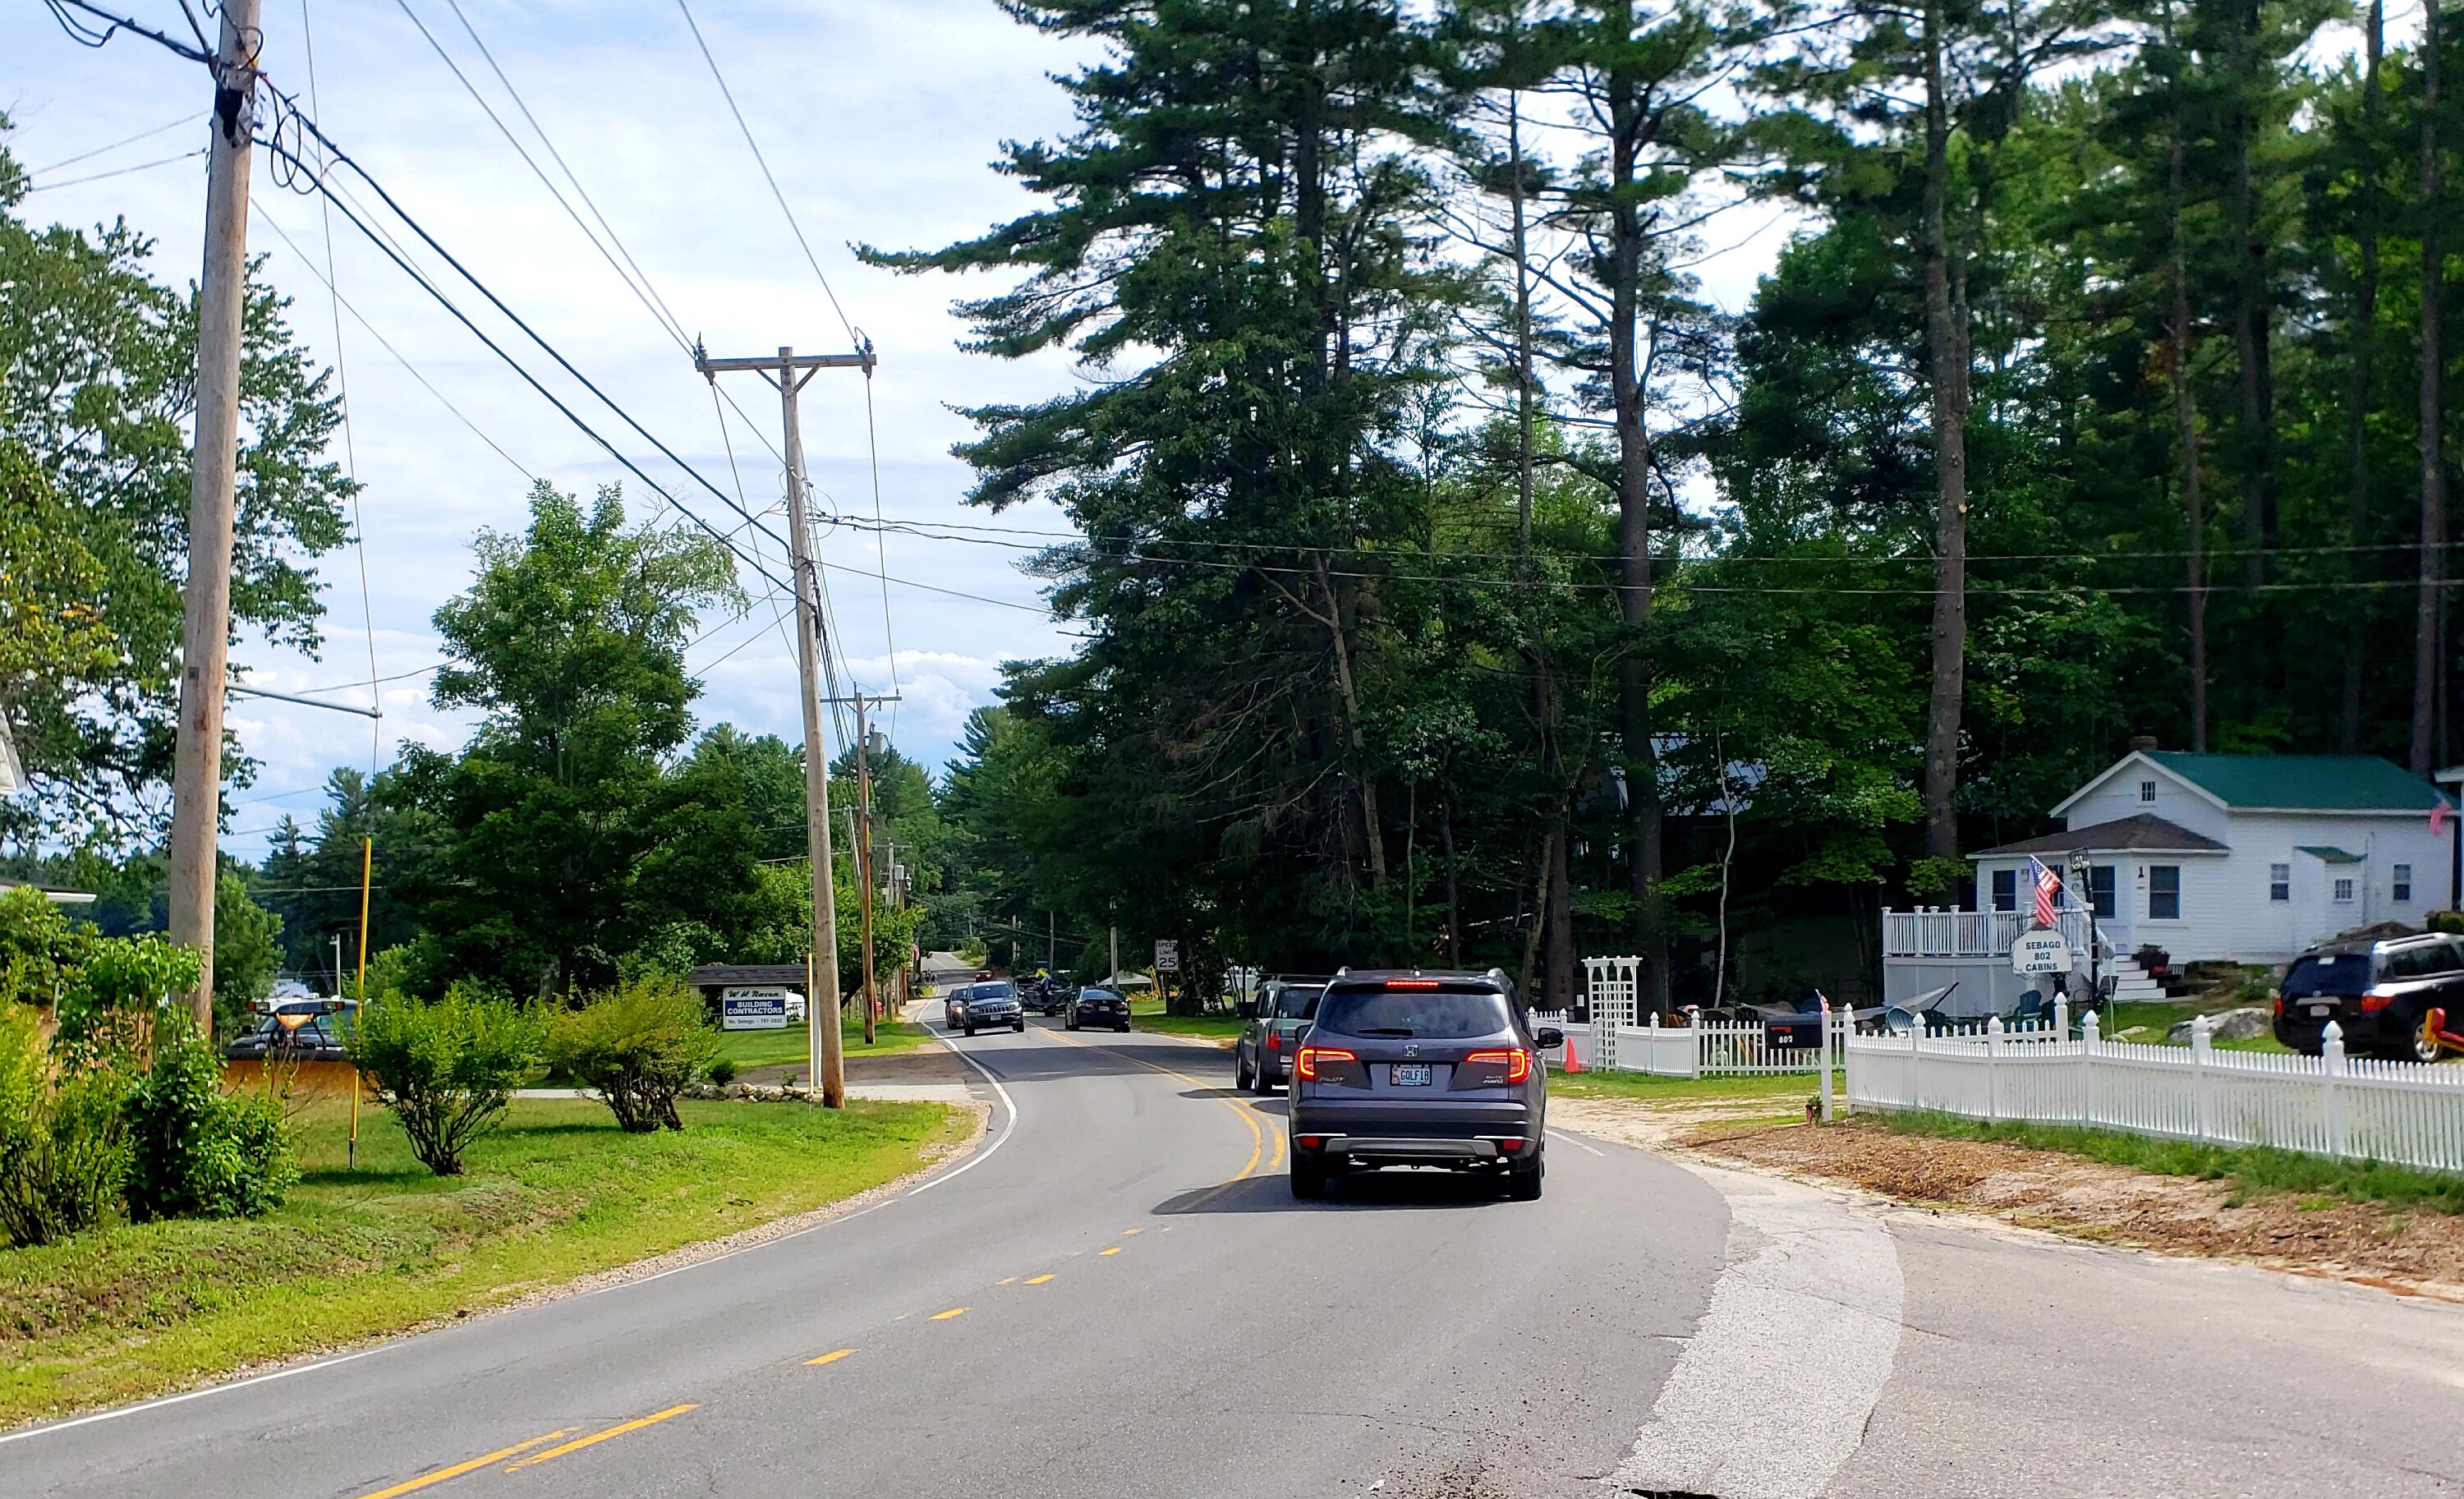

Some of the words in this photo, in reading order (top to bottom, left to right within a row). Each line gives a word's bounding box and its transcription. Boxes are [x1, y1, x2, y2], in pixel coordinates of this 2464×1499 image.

[2025, 940, 2061, 950] SEBAGO
[2034, 951, 2051, 960] 802
[1159, 957, 1177, 968] 25
[2025, 963, 2057, 972] CABINS
[1778, 1035, 1794, 1044] 802
